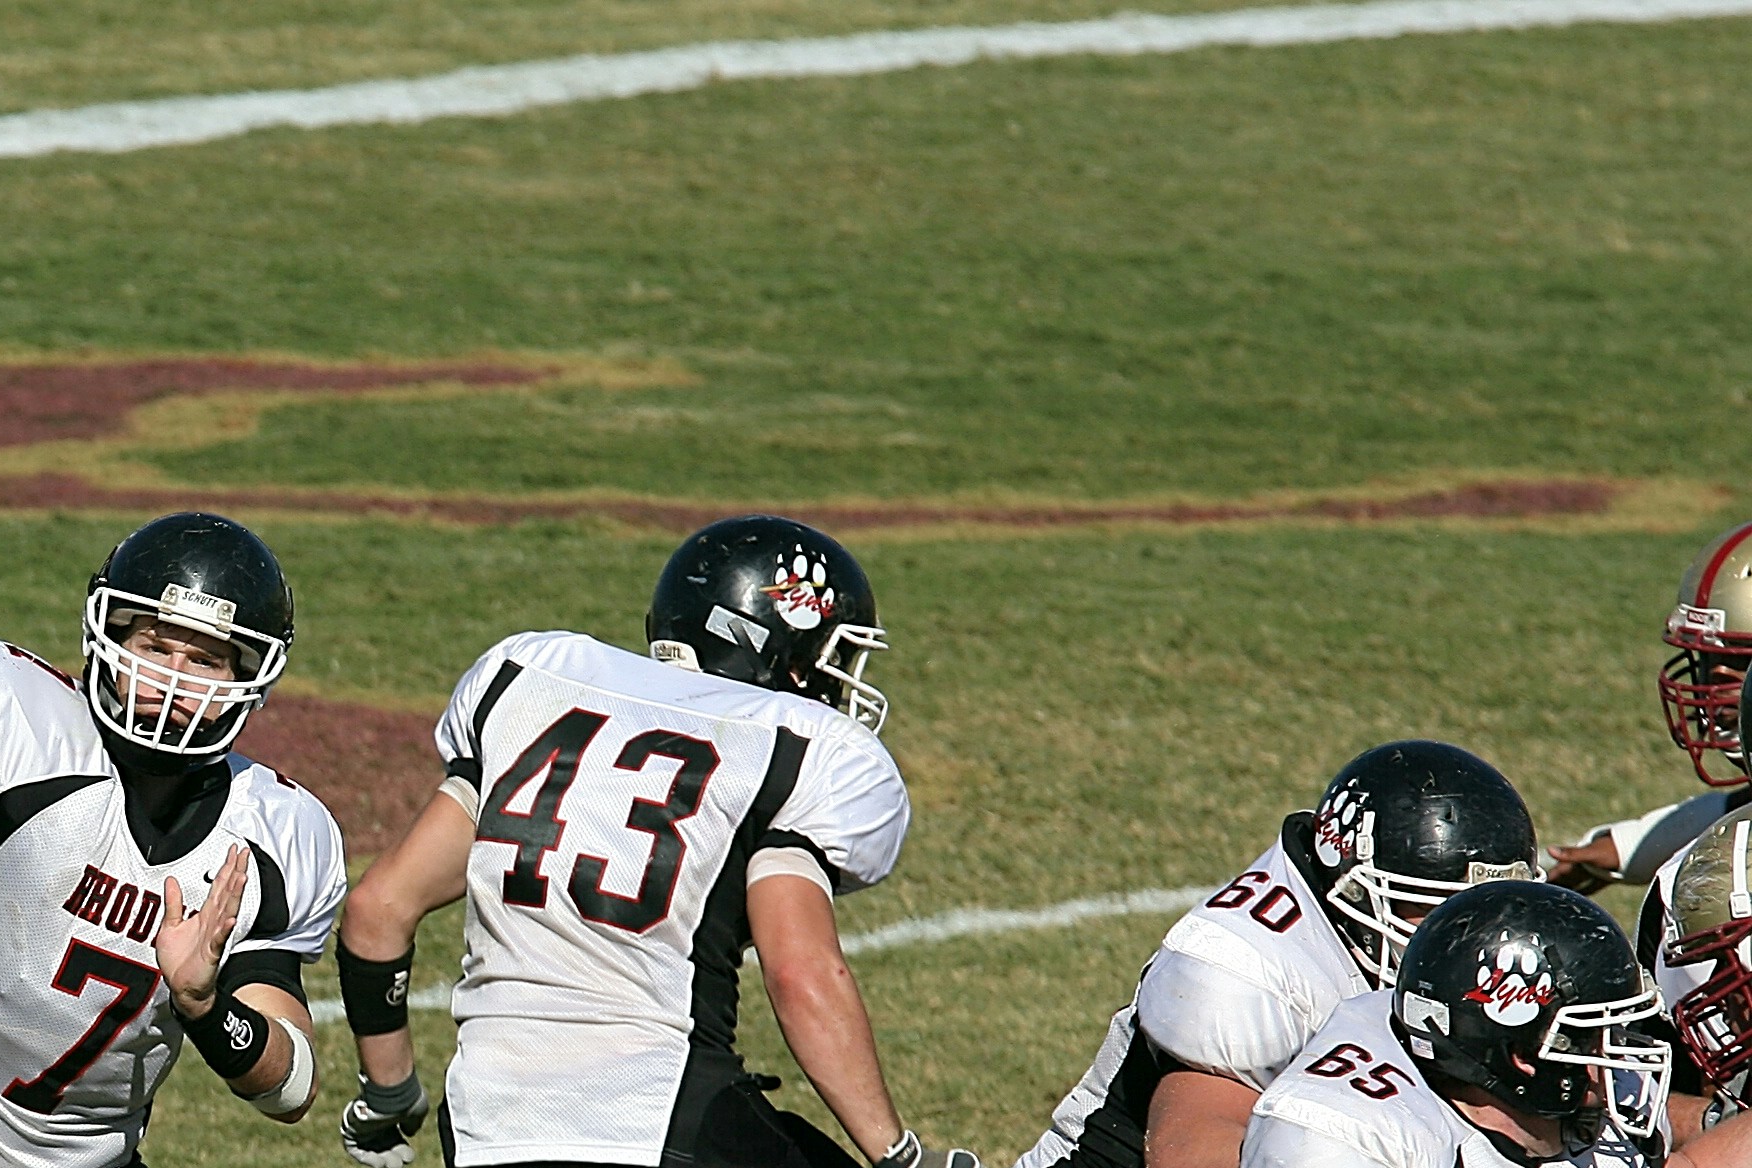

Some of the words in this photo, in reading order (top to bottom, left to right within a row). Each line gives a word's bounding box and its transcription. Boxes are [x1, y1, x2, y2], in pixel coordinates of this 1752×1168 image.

[476, 706, 722, 934] 43
[62, 864, 199, 949] RHOD
[1205, 871, 1304, 934] 60
[1, 937, 164, 1116] 7
[1462, 967, 1556, 1014] Lynx
[1305, 1043, 1417, 1101] 65
